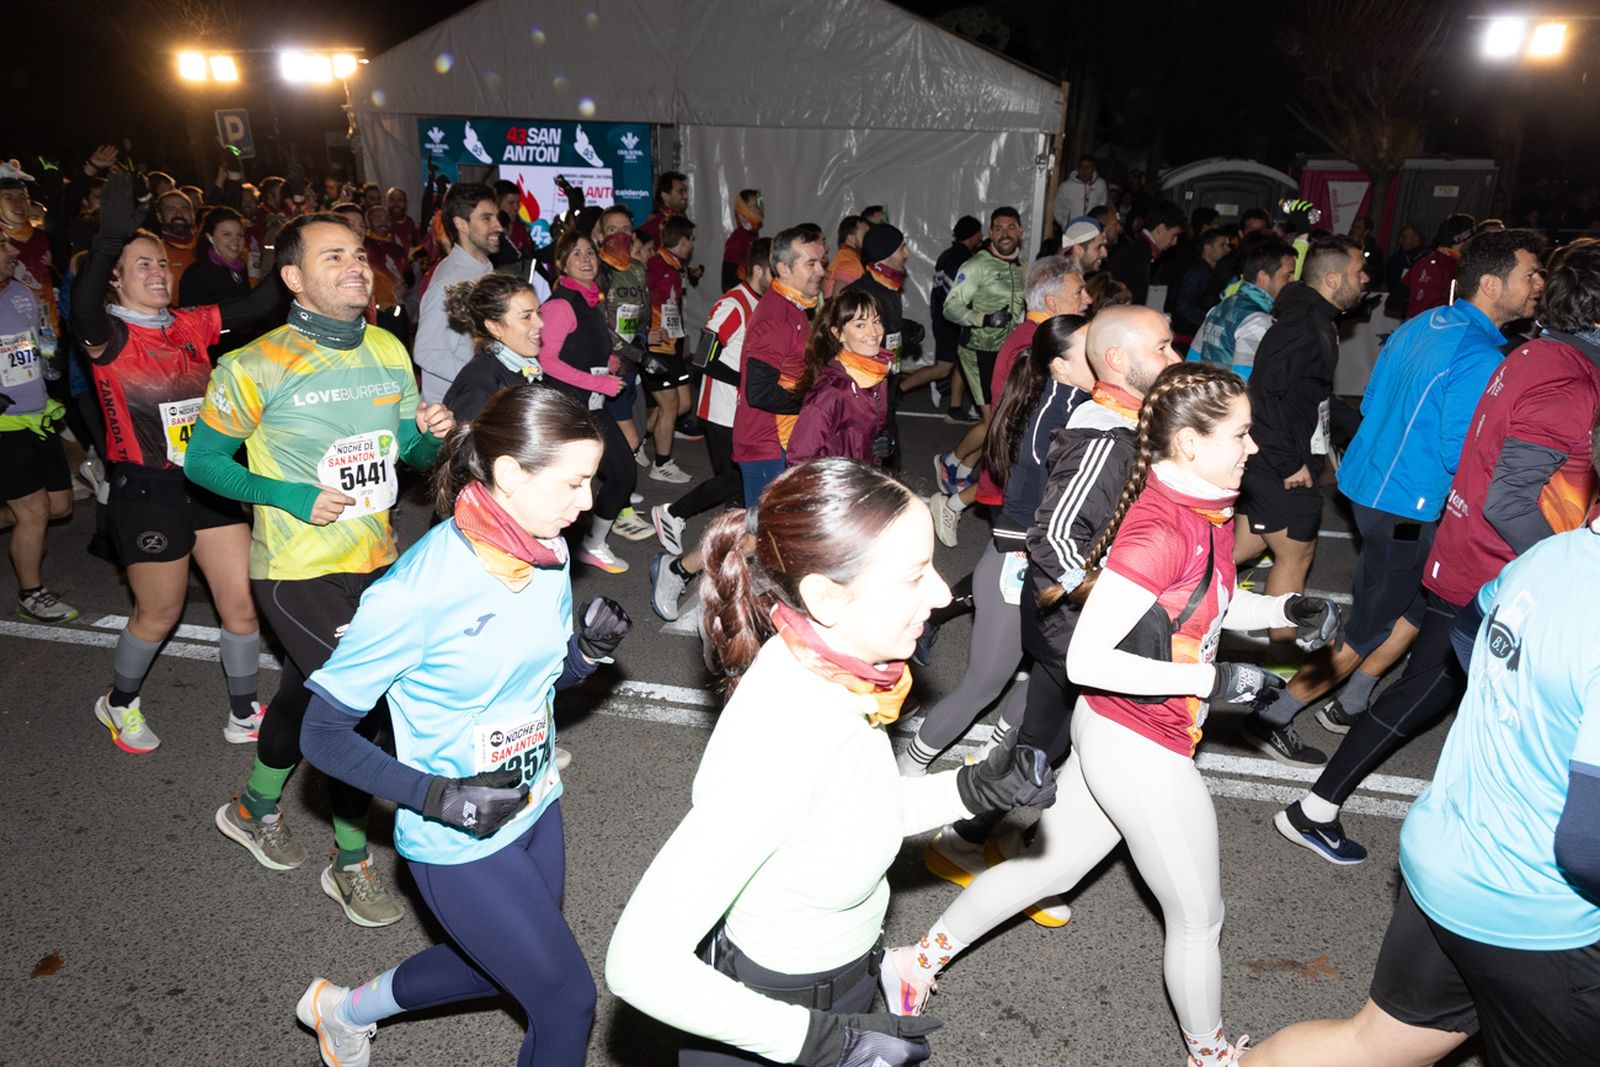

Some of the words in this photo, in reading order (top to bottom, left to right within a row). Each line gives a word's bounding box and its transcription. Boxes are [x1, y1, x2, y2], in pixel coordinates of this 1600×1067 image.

[224, 115, 244, 145] P
[502, 142, 560, 163] ANTÓN
[292, 381, 401, 408] LOVEBURPEES
[99, 379, 123, 444] ZANCADA
[337, 444, 362, 455] NOCHE
[363, 441, 374, 450] DE
[327, 456, 346, 468] SAN
[339, 459, 387, 491] 5441
[505, 723, 535, 745] NOCHE
[490, 745, 513, 764] SAN
